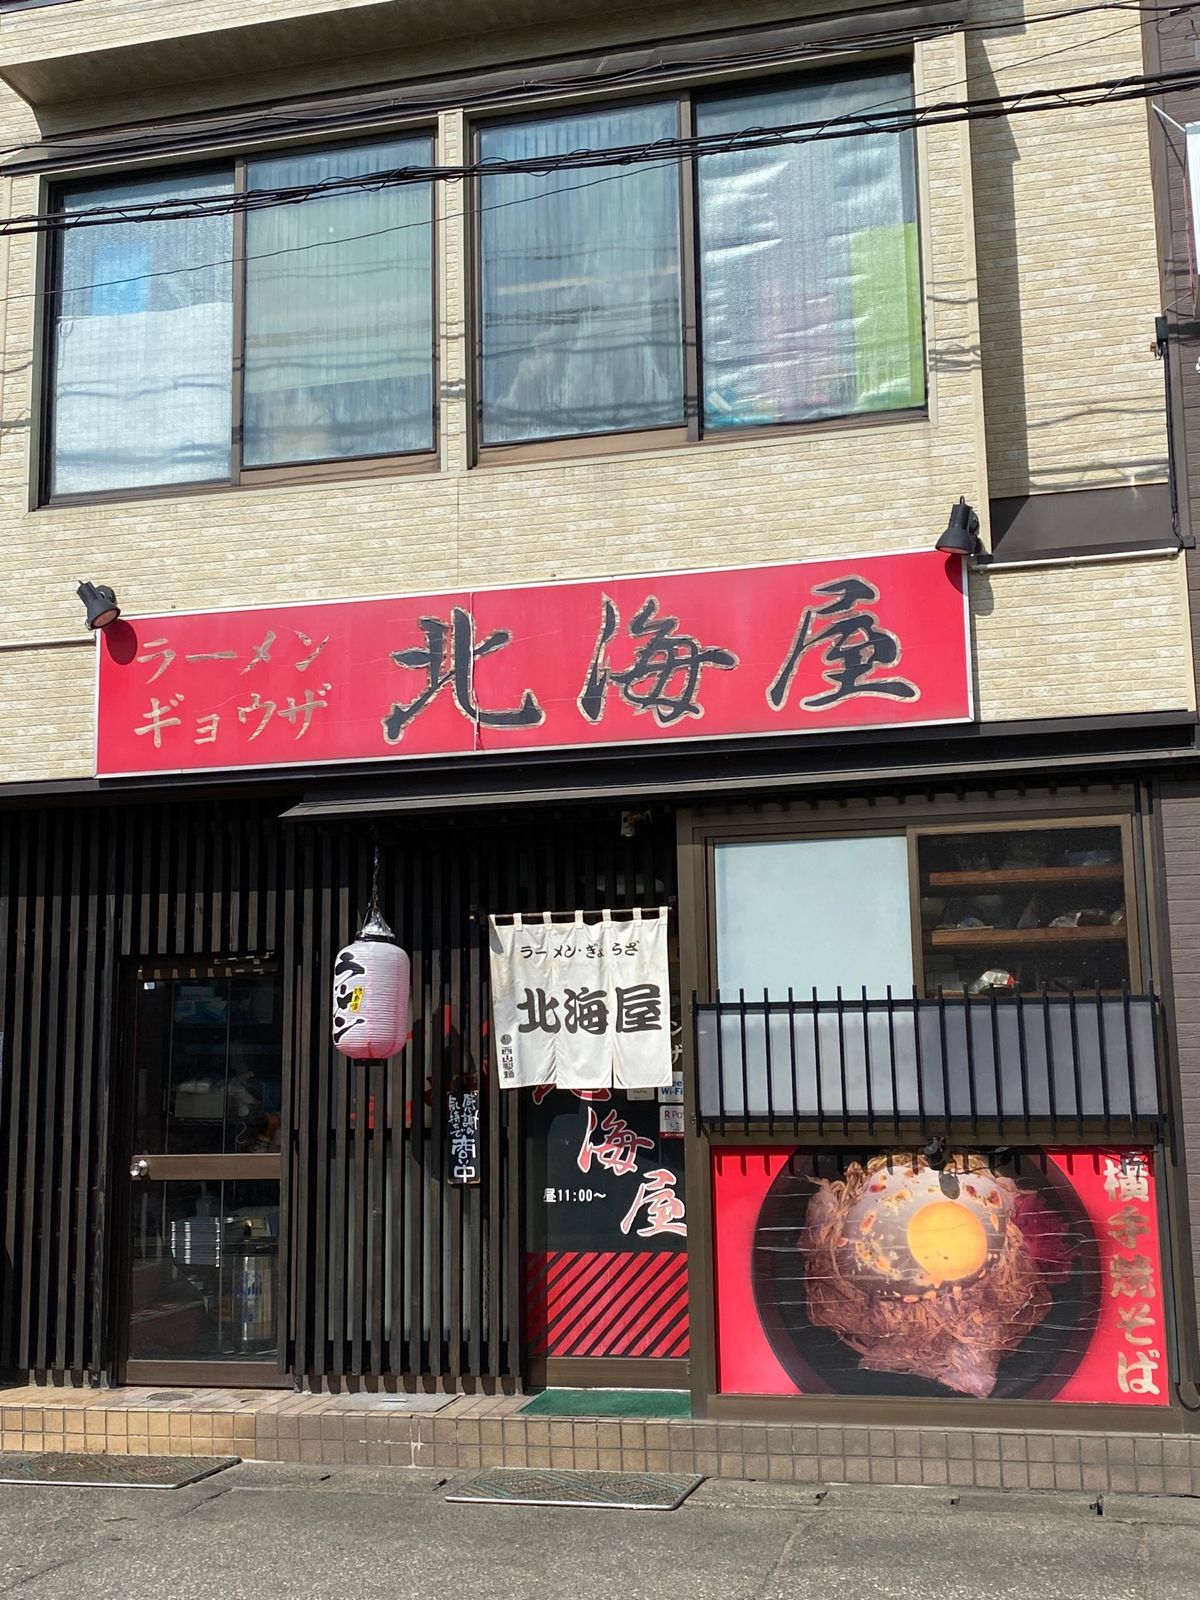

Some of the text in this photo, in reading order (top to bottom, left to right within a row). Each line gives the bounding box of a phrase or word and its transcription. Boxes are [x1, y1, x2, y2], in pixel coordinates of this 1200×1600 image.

[136, 627, 332, 685] ラーメン
[382, 574, 921, 745] 北海屋
[133, 682, 333, 748] ギョウザ
[516, 984, 664, 1035] 北海屋
[661, 1087, 683, 1096] Wi-Fi
[672, 1110, 684, 1118] Pa
[451, 1134, 477, 1184] 商い中
